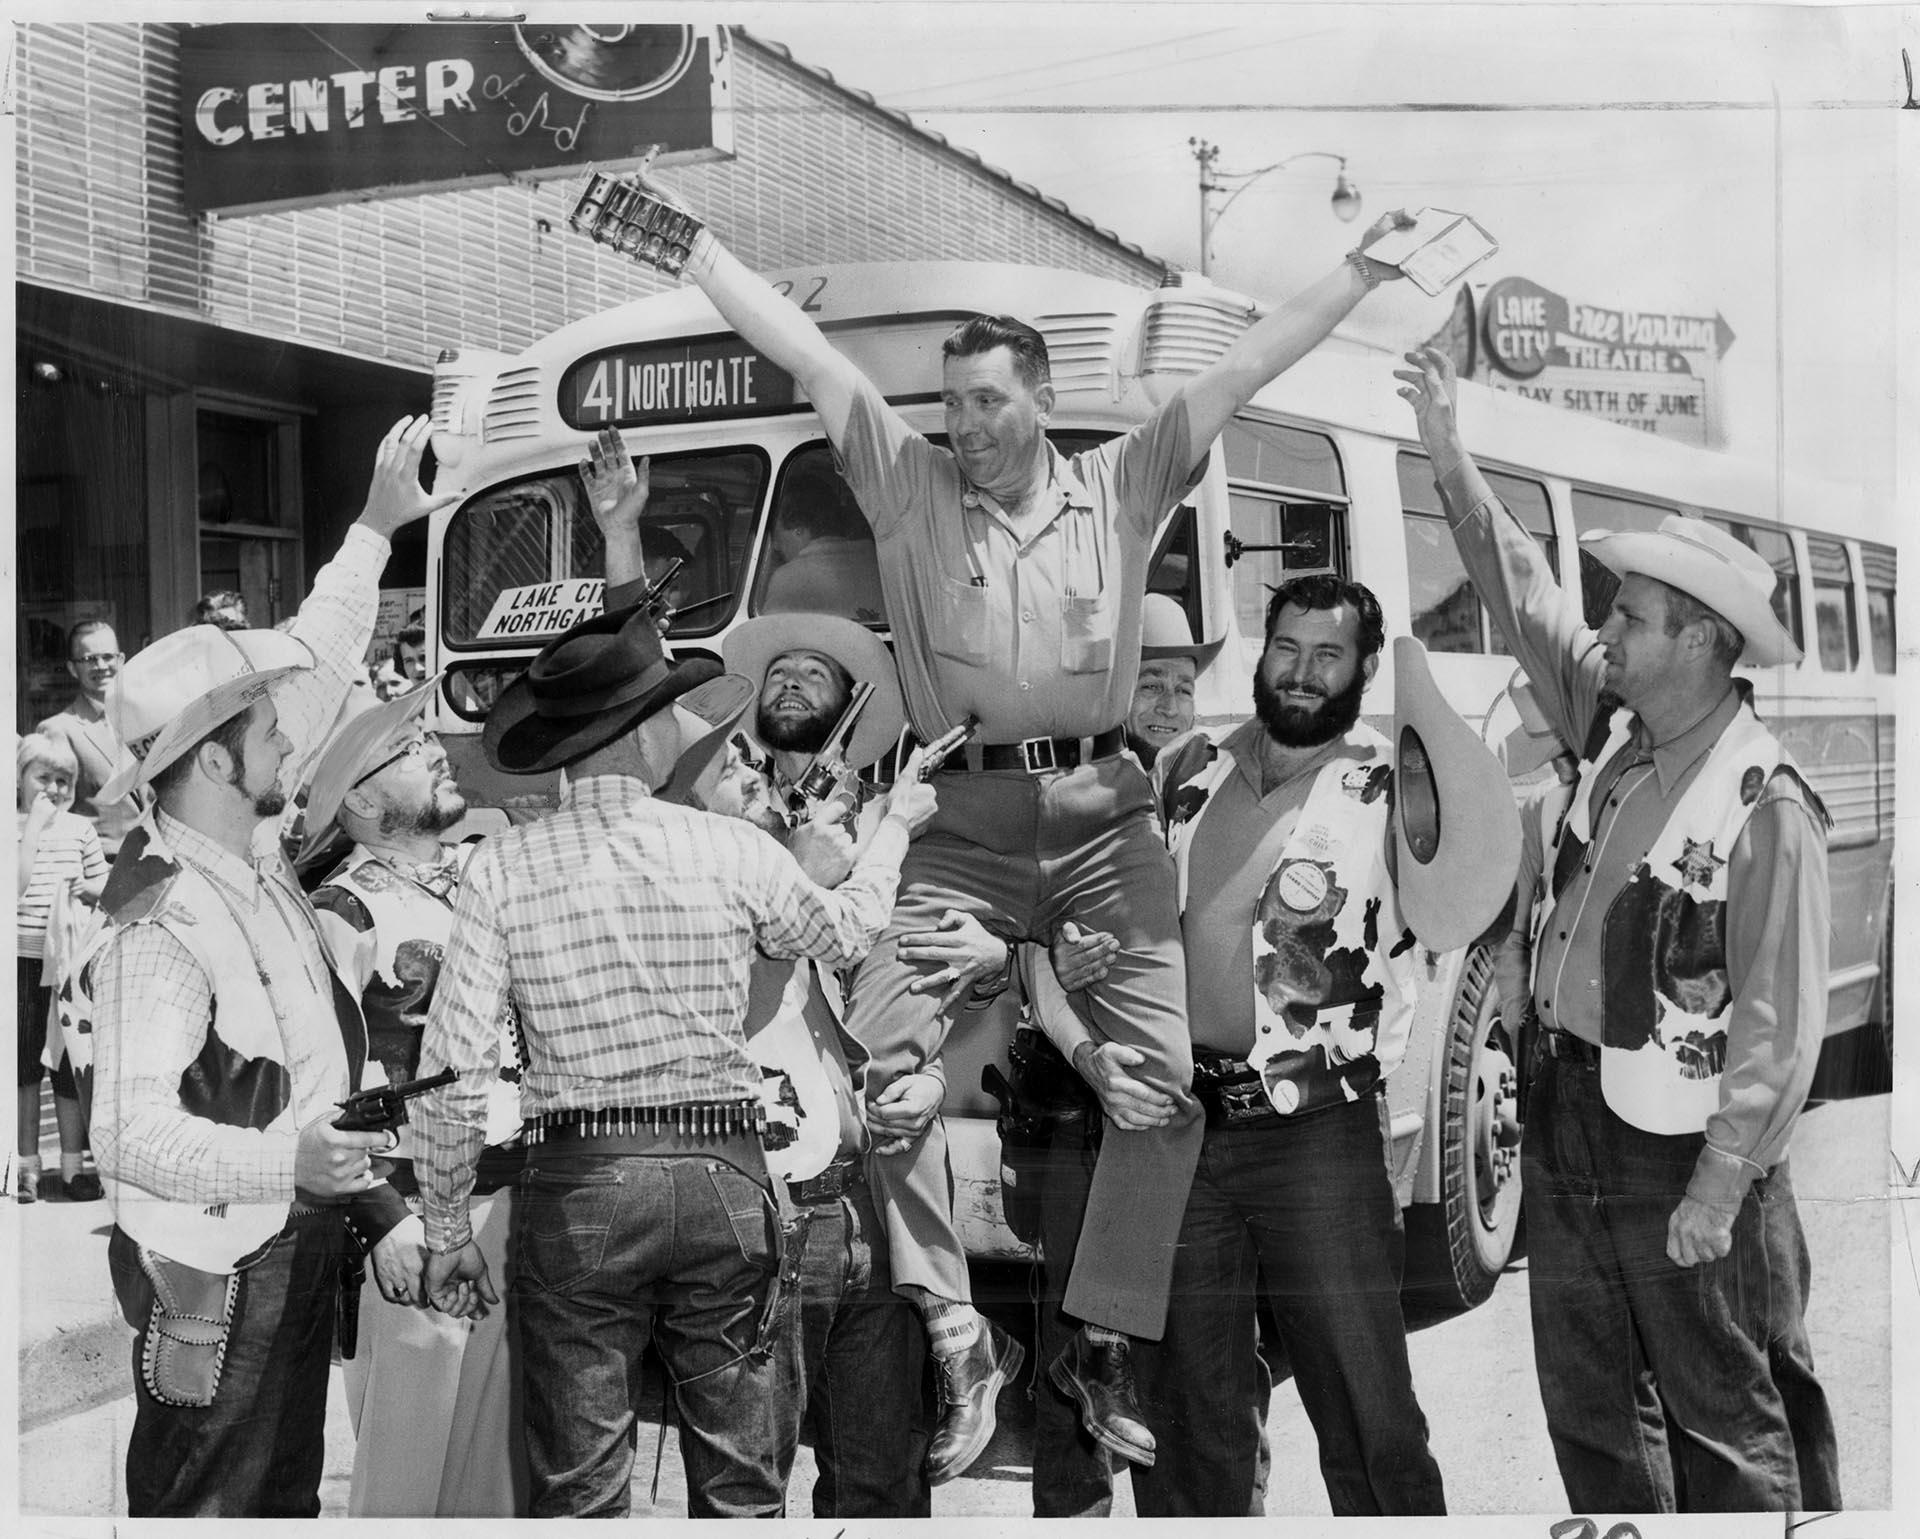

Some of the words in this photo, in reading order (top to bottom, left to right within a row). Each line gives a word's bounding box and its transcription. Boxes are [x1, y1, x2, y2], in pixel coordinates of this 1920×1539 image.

[195, 58, 477, 146] CENTER
[1496, 296, 1547, 326] LAKE
[1568, 304, 1620, 343] Free
[1622, 310, 1717, 353] Parking
[1496, 328, 1550, 360] CITY
[1565, 347, 1669, 372] THEATRE
[582, 358, 623, 421] 41
[628, 356, 757, 412] NORTHGATE
[1563, 388, 1619, 412] SIXTH
[1627, 392, 1648, 414] OF
[1655, 394, 1700, 417] JUNE
[511, 584, 563, 610] LAKE
[575, 582, 606, 604] CIT
[493, 606, 604, 634] NORTHGAT
